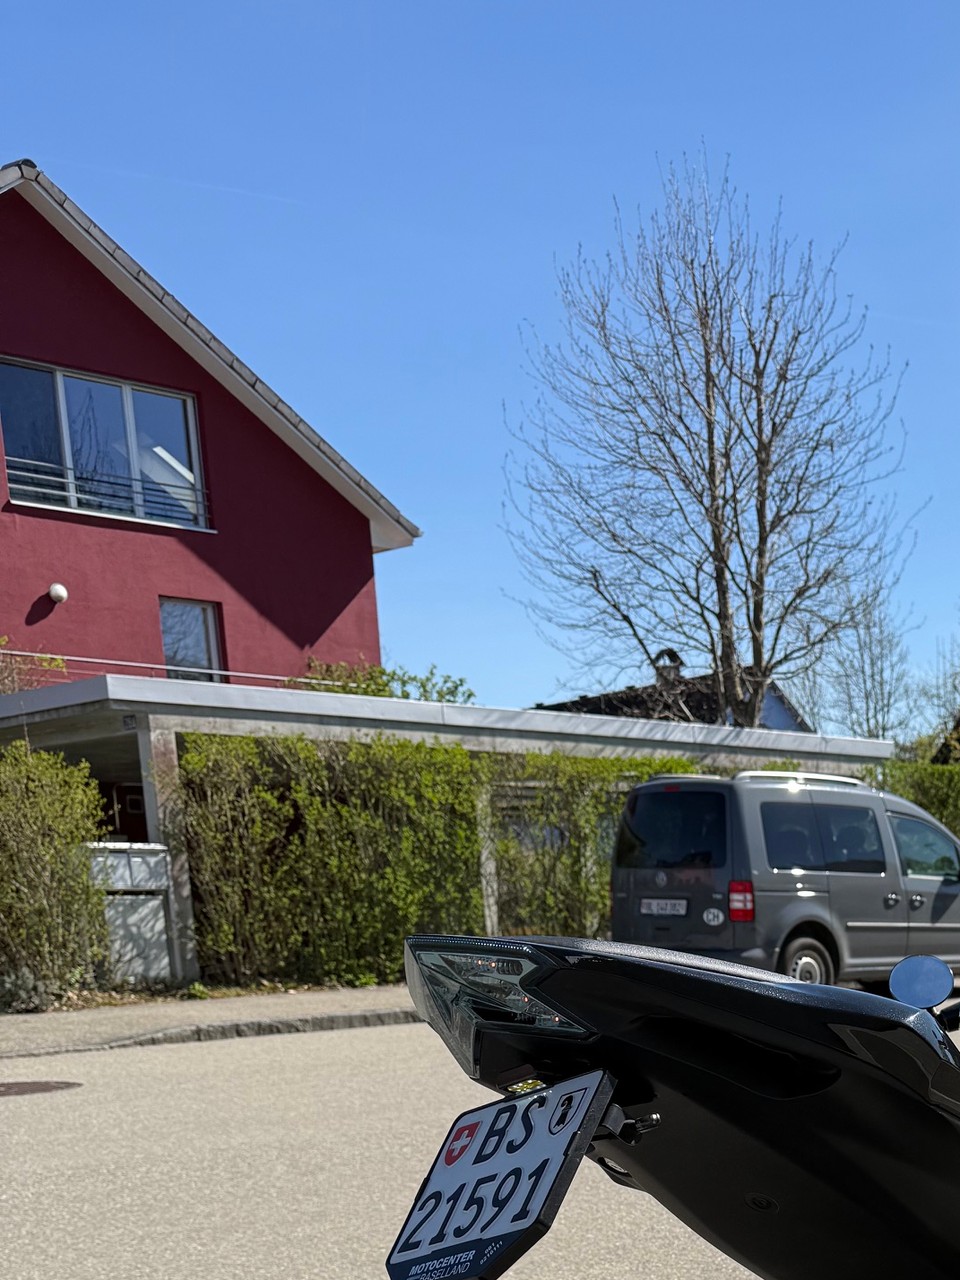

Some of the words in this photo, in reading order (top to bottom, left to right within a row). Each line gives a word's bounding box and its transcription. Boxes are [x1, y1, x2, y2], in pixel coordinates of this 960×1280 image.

[706, 910, 720, 922] CH
[472, 1095, 549, 1166] BS
[397, 1157, 550, 1254] 21591
[408, 1250, 476, 1276] MOTOCENTER
